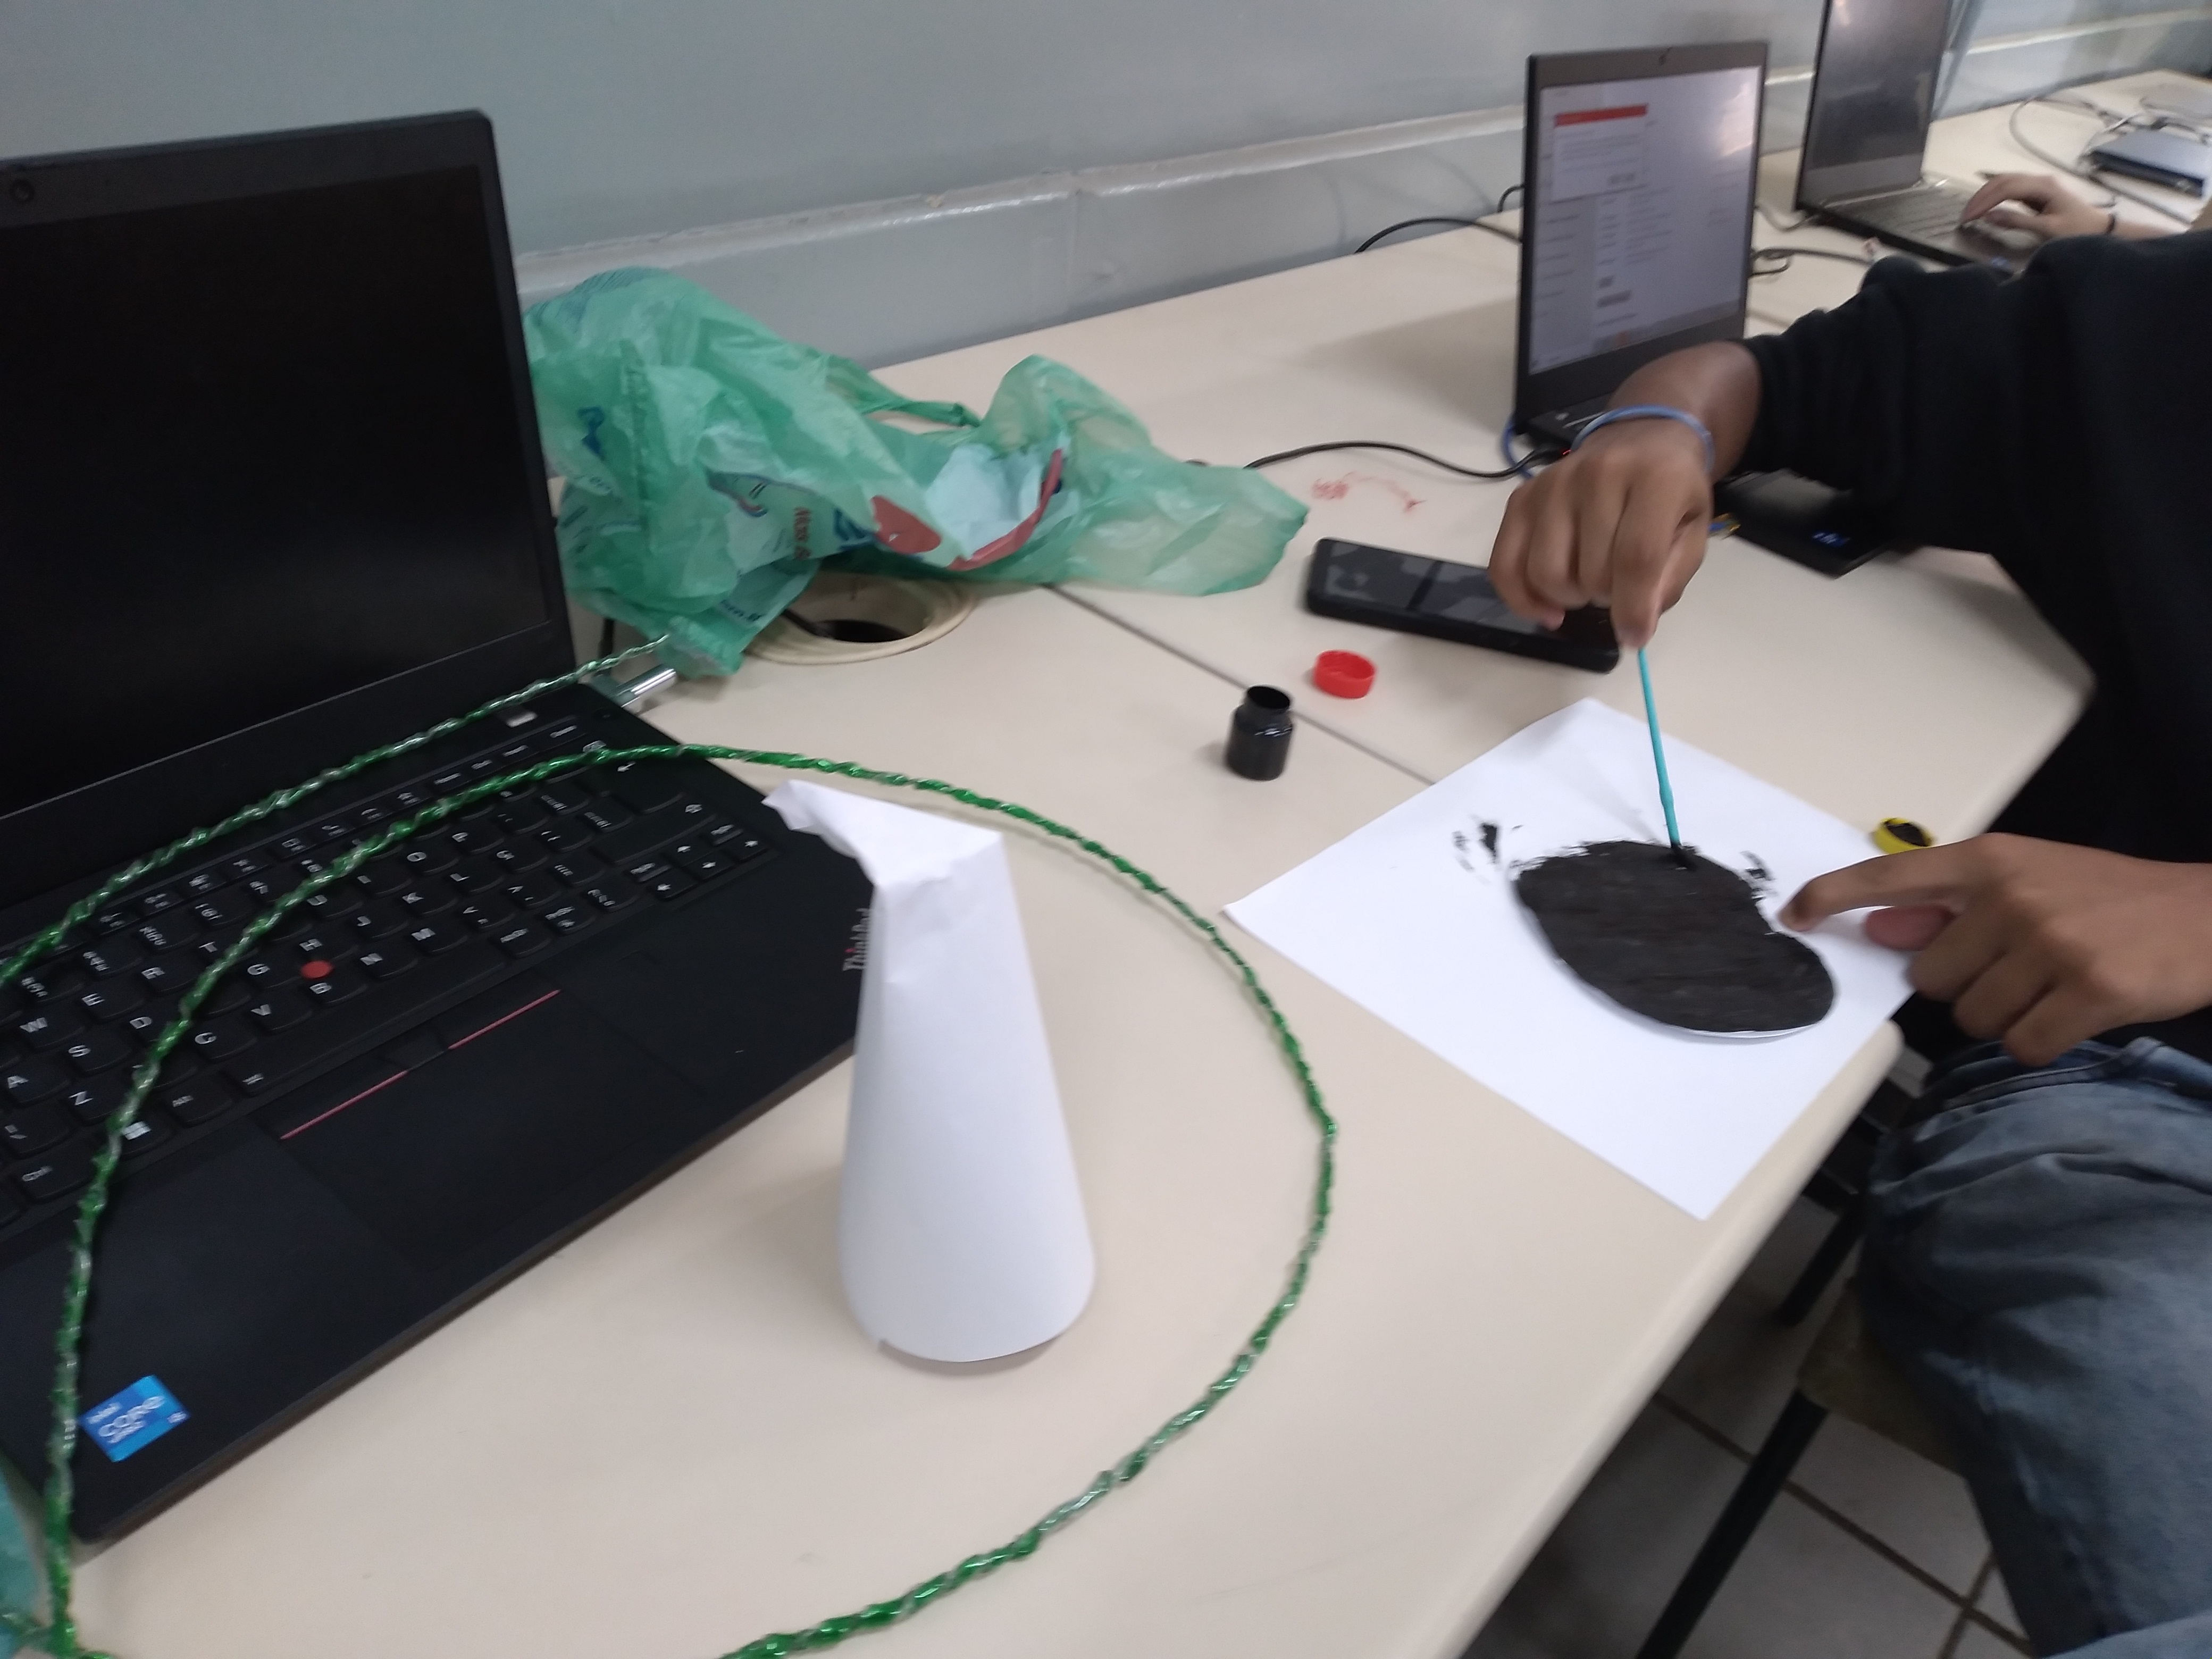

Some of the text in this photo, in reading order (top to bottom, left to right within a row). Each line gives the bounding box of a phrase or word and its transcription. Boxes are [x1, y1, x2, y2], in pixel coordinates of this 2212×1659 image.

[452, 832, 469, 843] P
[406, 851, 427, 862] O
[449, 873, 471, 882] L
[306, 894, 328, 906] U
[402, 892, 424, 904] K
[357, 916, 372, 927] J
[411, 928, 436, 941] M
[199, 941, 218, 952] T
[299, 938, 323, 951] H
[360, 953, 383, 966] N
[141, 967, 166, 979] R
[247, 963, 270, 975] G
[309, 982, 332, 994] B
[81, 993, 105, 1006] E
[250, 1003, 272, 1016] V
[19, 1017, 48, 1033] W
[129, 1016, 153, 1029] D
[195, 1032, 217, 1044] C
[68, 1045, 91, 1057] S
[7, 1075, 29, 1088] A
[68, 1091, 94, 1105] Z
